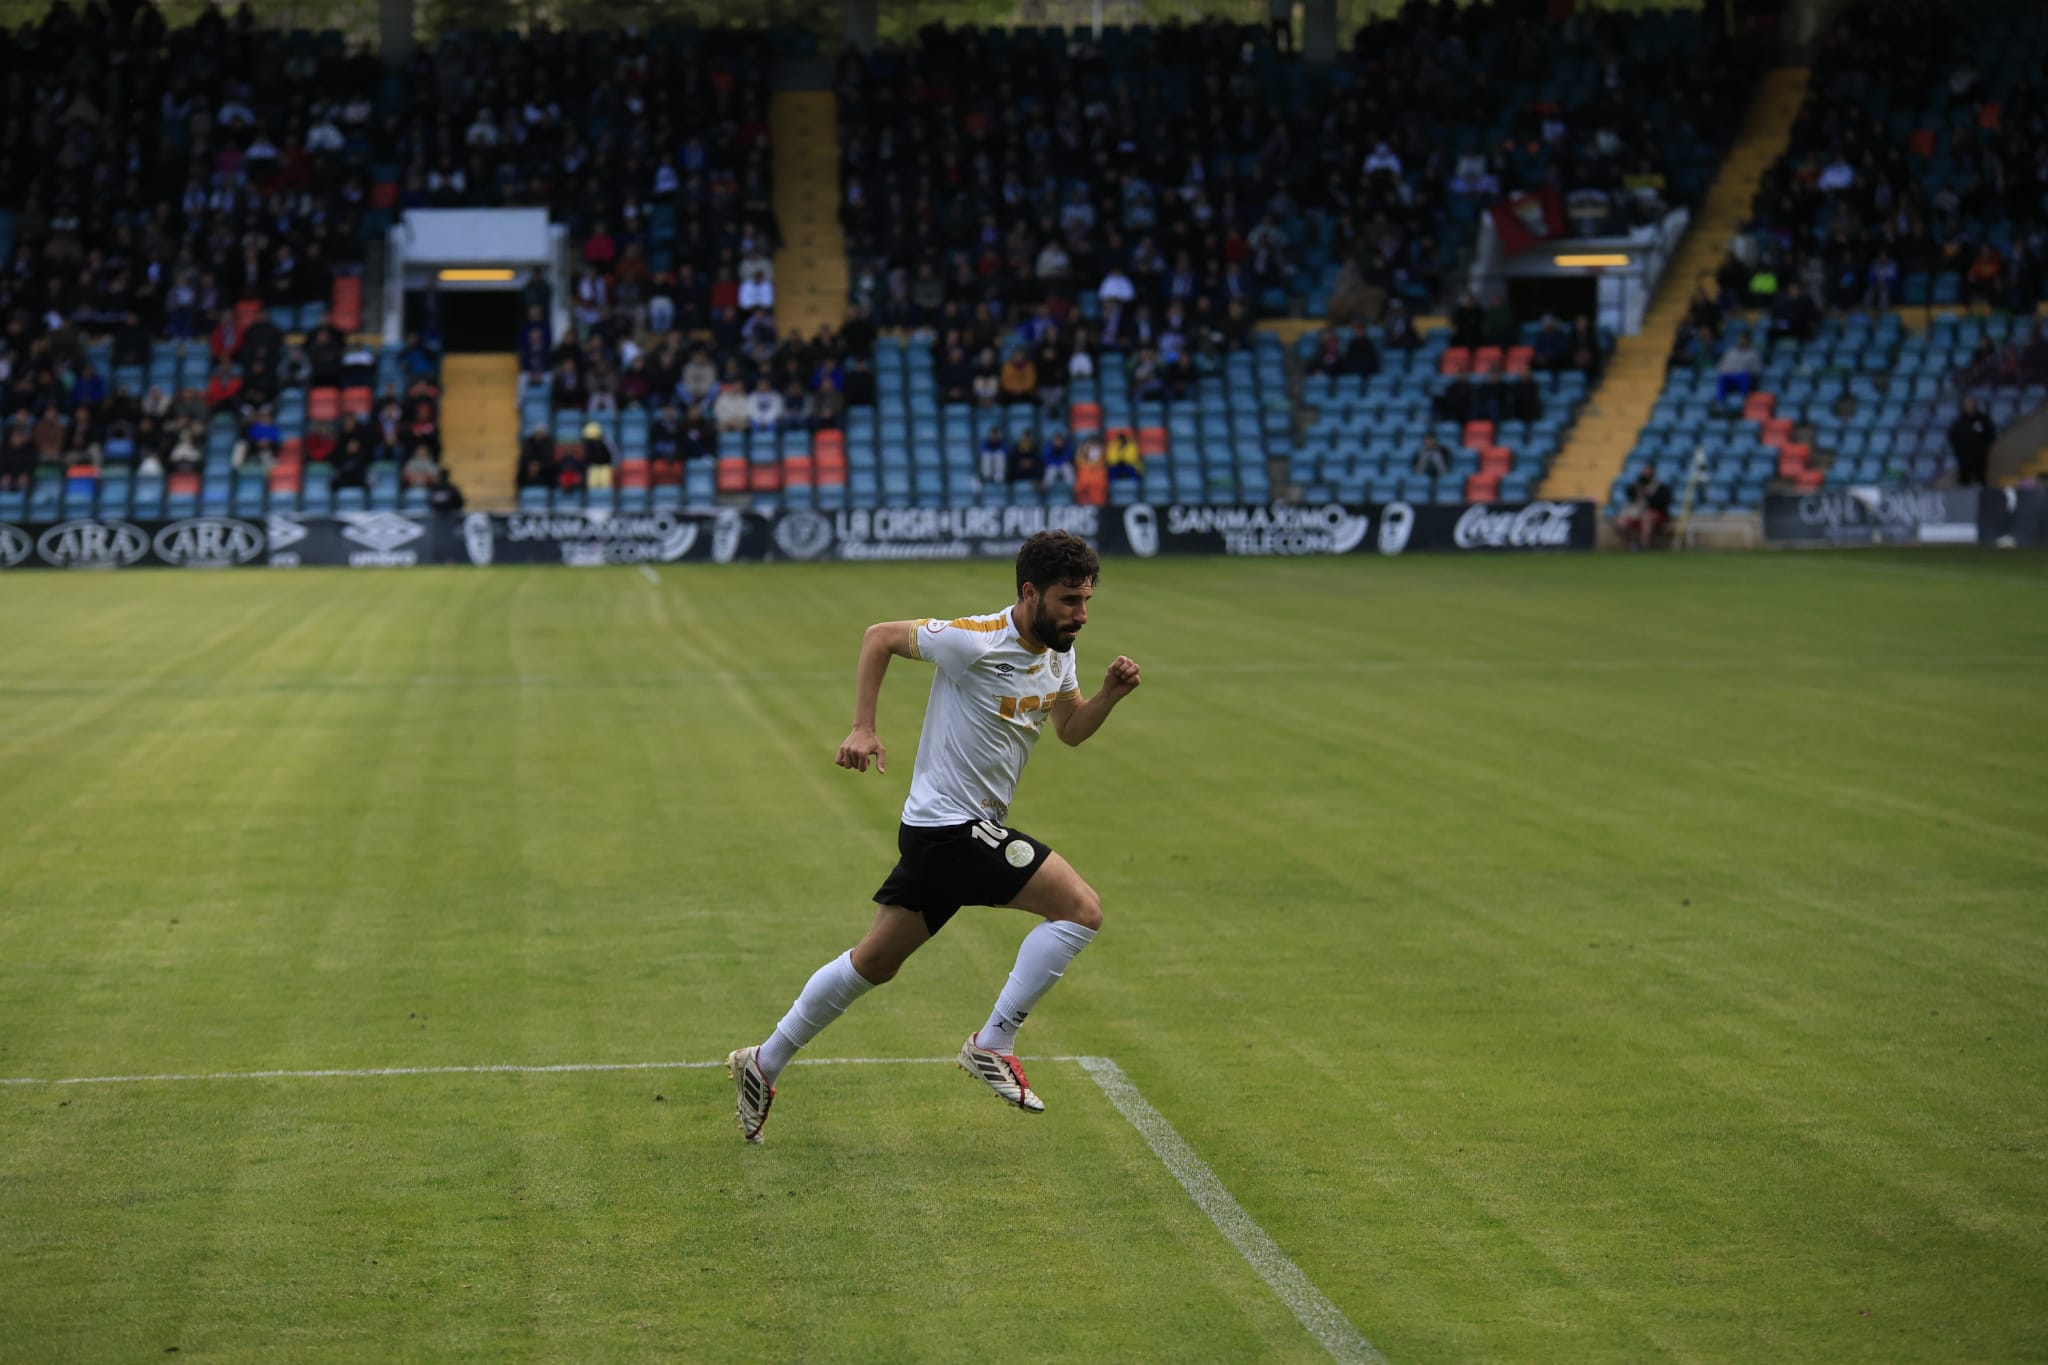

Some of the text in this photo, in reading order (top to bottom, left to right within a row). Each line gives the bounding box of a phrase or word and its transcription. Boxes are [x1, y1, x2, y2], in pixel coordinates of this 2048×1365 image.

[171, 521, 250, 561] ARA
[836, 508, 870, 541] LA
[873, 508, 941, 541] CASA
[951, 505, 1000, 539] LAS
[1224, 528, 1336, 555] TELECOM
[1453, 501, 1579, 548] Coca-Cola
[55, 523, 136, 562] ARA
[971, 819, 1009, 849] 10
